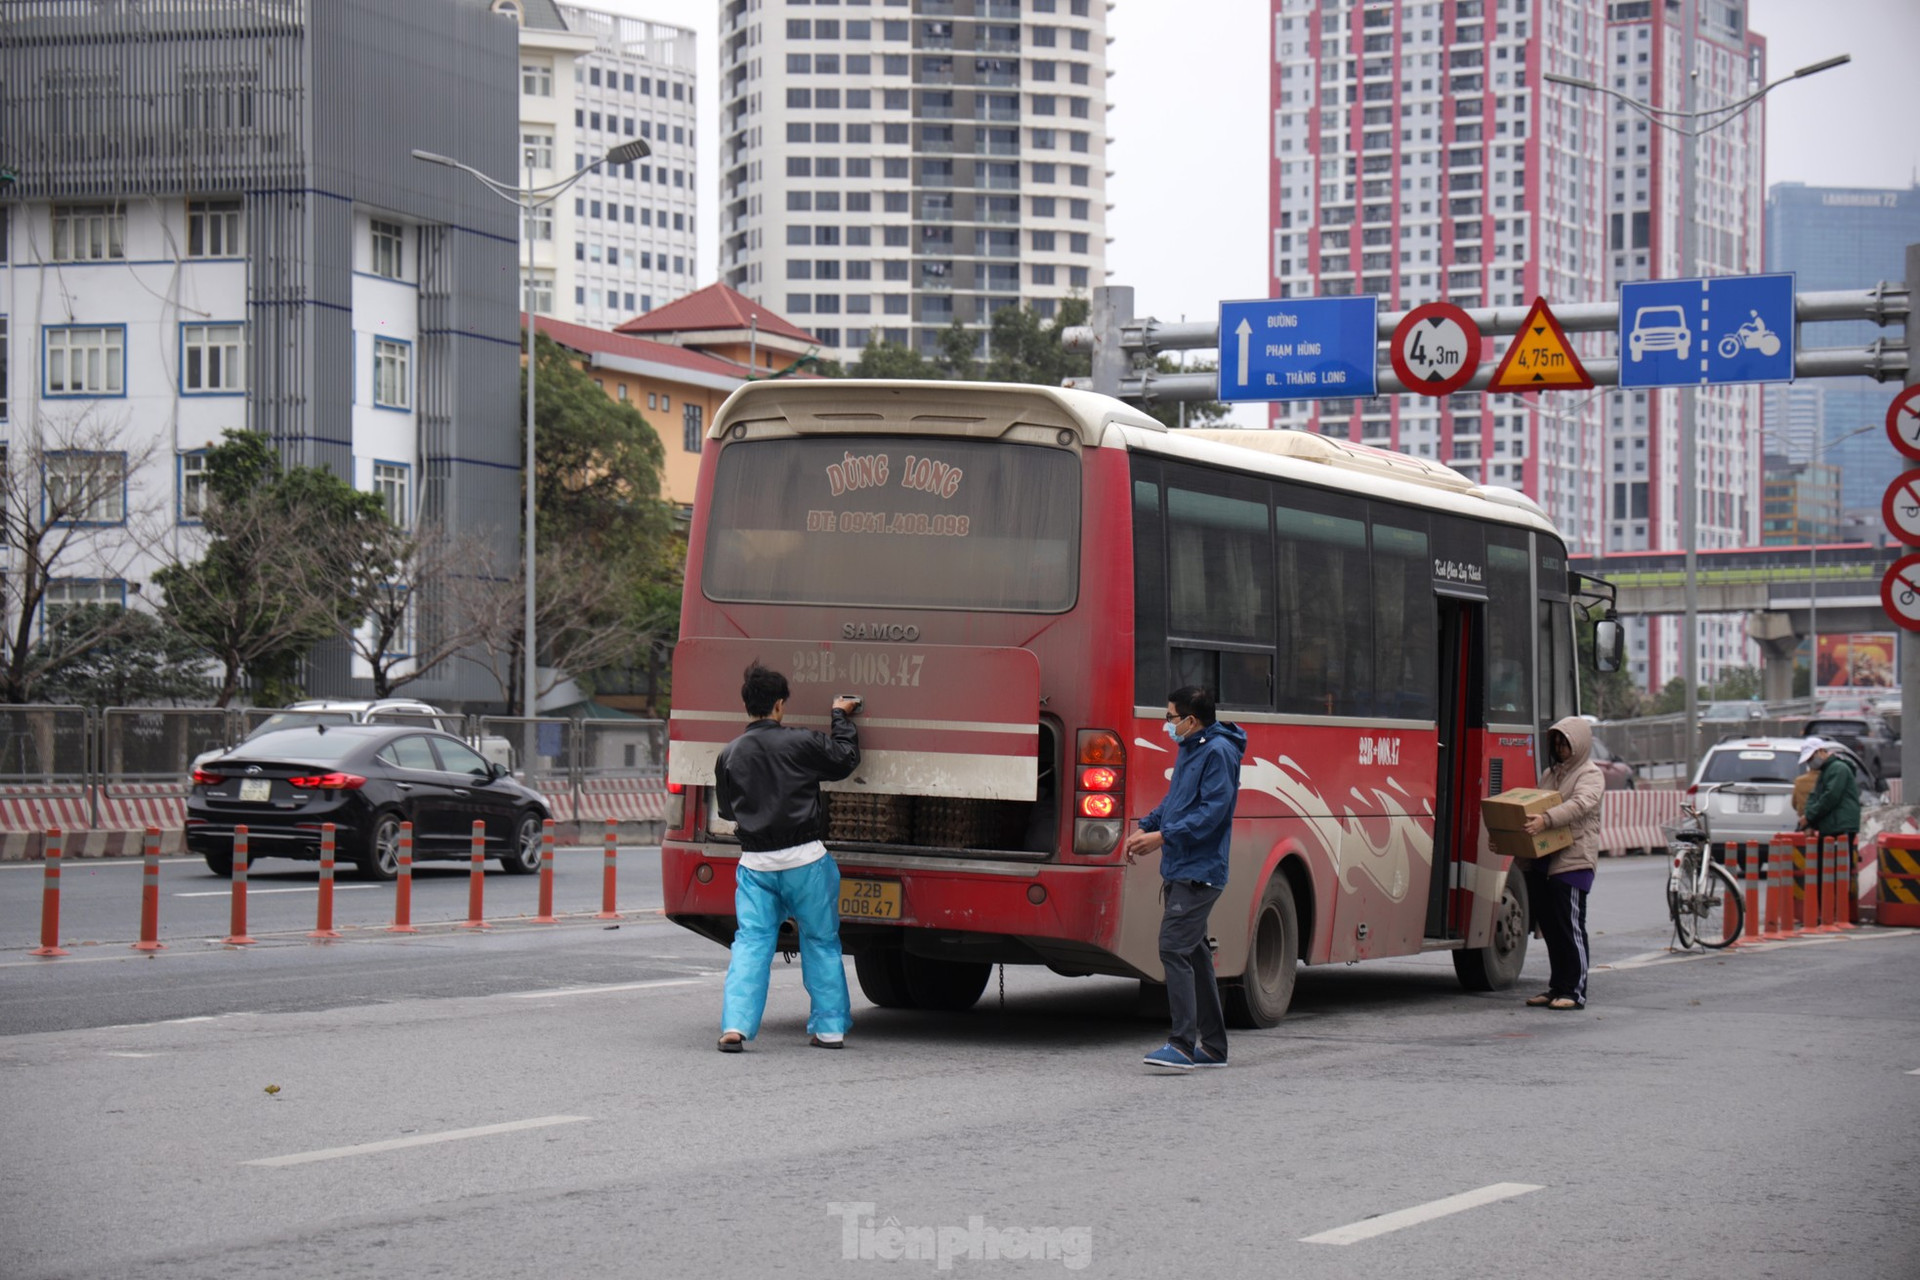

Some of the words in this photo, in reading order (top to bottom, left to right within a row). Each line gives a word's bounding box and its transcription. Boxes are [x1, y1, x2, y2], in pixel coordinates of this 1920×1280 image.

[1882, 193, 1898, 207] 72
[1267, 312, 1298, 328] ĐƯỜNG
[1266, 344, 1292, 359] PHẠM
[1297, 340, 1321, 356] HÙNG
[1410, 330, 1459, 368] 4,3m
[1518, 348, 1565, 369] 4,75m
[1322, 371, 1346, 384] LONG
[902, 455, 963, 499] LONG
[807, 510, 836, 532] ĐT:
[839, 511, 970, 536] 0941.408.098
[842, 622, 920, 641] SAMCO
[854, 882, 882, 898] 22B
[842, 898, 893, 916] 008.47
